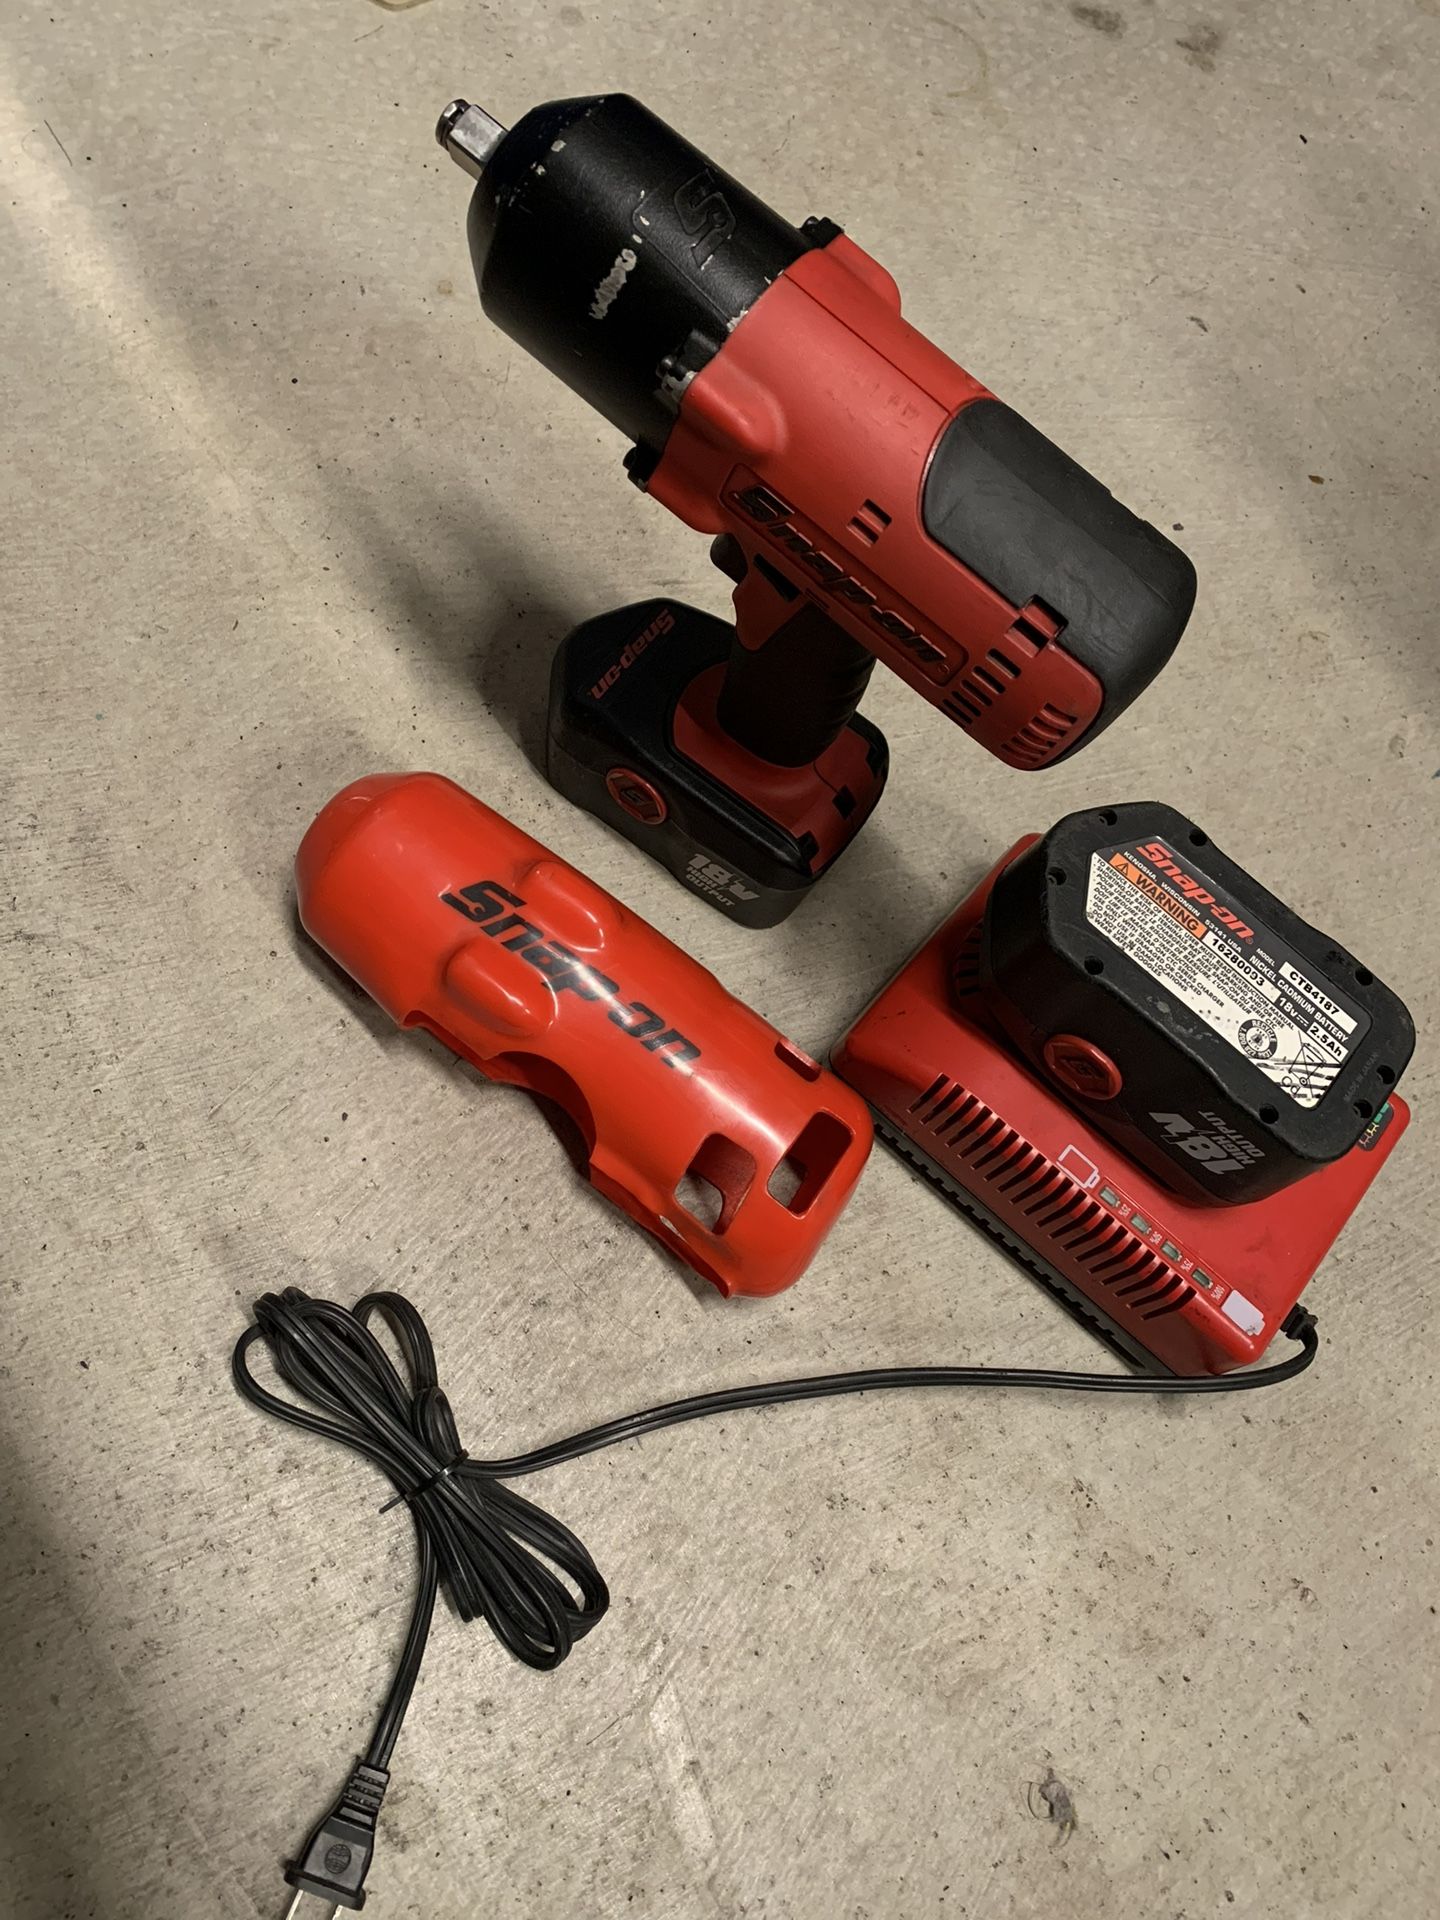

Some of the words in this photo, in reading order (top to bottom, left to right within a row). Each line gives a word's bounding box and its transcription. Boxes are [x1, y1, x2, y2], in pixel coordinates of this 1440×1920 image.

[733, 486, 947, 662] Snap-on
[591, 608, 675, 699] Snap-on
[685, 873, 735, 906] OUTPUT
[686, 865, 718, 888] HIGH
[688, 854, 759, 900] 18V
[1133, 873, 1200, 932] WARNING
[1135, 842, 1254, 940] Snap-on
[1093, 886, 1109, 900] DOIT
[1108, 898, 1121, 910] LIRE
[1120, 909, 1128, 917] LE
[1128, 916, 1153, 938] MANUEL
[1096, 880, 1114, 897] POUR
[1137, 915, 1148, 926] LES
[1148, 924, 1174, 948] RISQUES
[1173, 946, 1183, 955] DE
[1096, 858, 1106, 867] TO
[1105, 866, 1127, 885] REDUCE
[1127, 884, 1139, 895] THE
[1138, 894, 1152, 906] RISK
[1152, 905, 1161, 914] OF
[1183, 932, 1199, 946] USER
[1198, 945, 1215, 960] MUST
[1215, 959, 1231, 974] READ
[1230, 972, 1269, 1007] INSTRUCTION
[1268, 1006, 1295, 1030] MANUAL
[1160, 881, 1201, 917] WISCONSIN
[1204, 918, 1227, 939] 53141
[1226, 938, 1242, 953] USA
[1092, 901, 1103, 911] DO
[1102, 910, 1117, 923] NOT
[1116, 921, 1128, 933] USE
[1134, 937, 1165, 964] DAMAGED
[1164, 962, 1175, 972] OR
[1174, 971, 1202, 996] CRACKED
[1092, 909, 1102, 919] DO
[1102, 917, 1116, 930] NOT
[1115, 929, 1128, 940] USE
[1135, 946, 1155, 964] DAMP
[1154, 961, 1188, 991] LOCATIONS
[1093, 917, 1112, 934] WEAR
[1112, 933, 1133, 952] SAFETY
[1132, 950, 1162, 976] GOGGLES
[1093, 894, 1105, 905] USE
[1104, 904, 1121, 919] ONLY
[1121, 918, 1138, 933] WITH
[1137, 931, 1166, 957] SNAP-ON
[1165, 955, 1177, 967] CTC
[1176, 965, 1197, 983] SERIES
[1195, 981, 1224, 1007] CHARGER
[1096, 865, 1126, 891] SHORTING
[1125, 889, 1134, 898] OF
[1133, 897, 1157, 918] BATTERY
[1157, 917, 1188, 944] TERMINALS
[1187, 943, 1201, 956] MAY
[1200, 954, 1219, 971] CAUSE
[1219, 970, 1249, 997] SPARKING
[1247, 995, 1273, 1018] AND/OR
[1271, 1016, 1285, 1028] FIRE
[1096, 872, 1114, 889] POUR
[1113, 887, 1134, 906] USAGE
[1133, 904, 1149, 918] AVEC
[1155, 923, 1188, 952] CHARGEUR
[1187, 950, 1196, 958] DE
[1195, 957, 1211, 972] PILES
[1211, 971, 1240, 996] SNAP-ON
[1239, 995, 1250, 1005] DU
[1264, 1017, 1277, 1029] CTC
[1210, 937, 1265, 986] 16280093
[1248, 954, 1278, 982] NICKEL
[1275, 979, 1315, 1014] CADMIUM
[1313, 1011, 1348, 1043] BATTERY
[1255, 947, 1276, 966] MODEL
[1287, 970, 1340, 1016] CTB4187
[1252, 1020, 1276, 1041] RECYCLE
[1308, 1025, 1344, 1057] 2.5Ah
[1279, 1074, 1301, 1095] Cd
[1148, 1112, 1244, 1174] 18V
[1197, 1111, 1265, 1157] OUTPUT
[1210, 1133, 1256, 1165] HIGH
